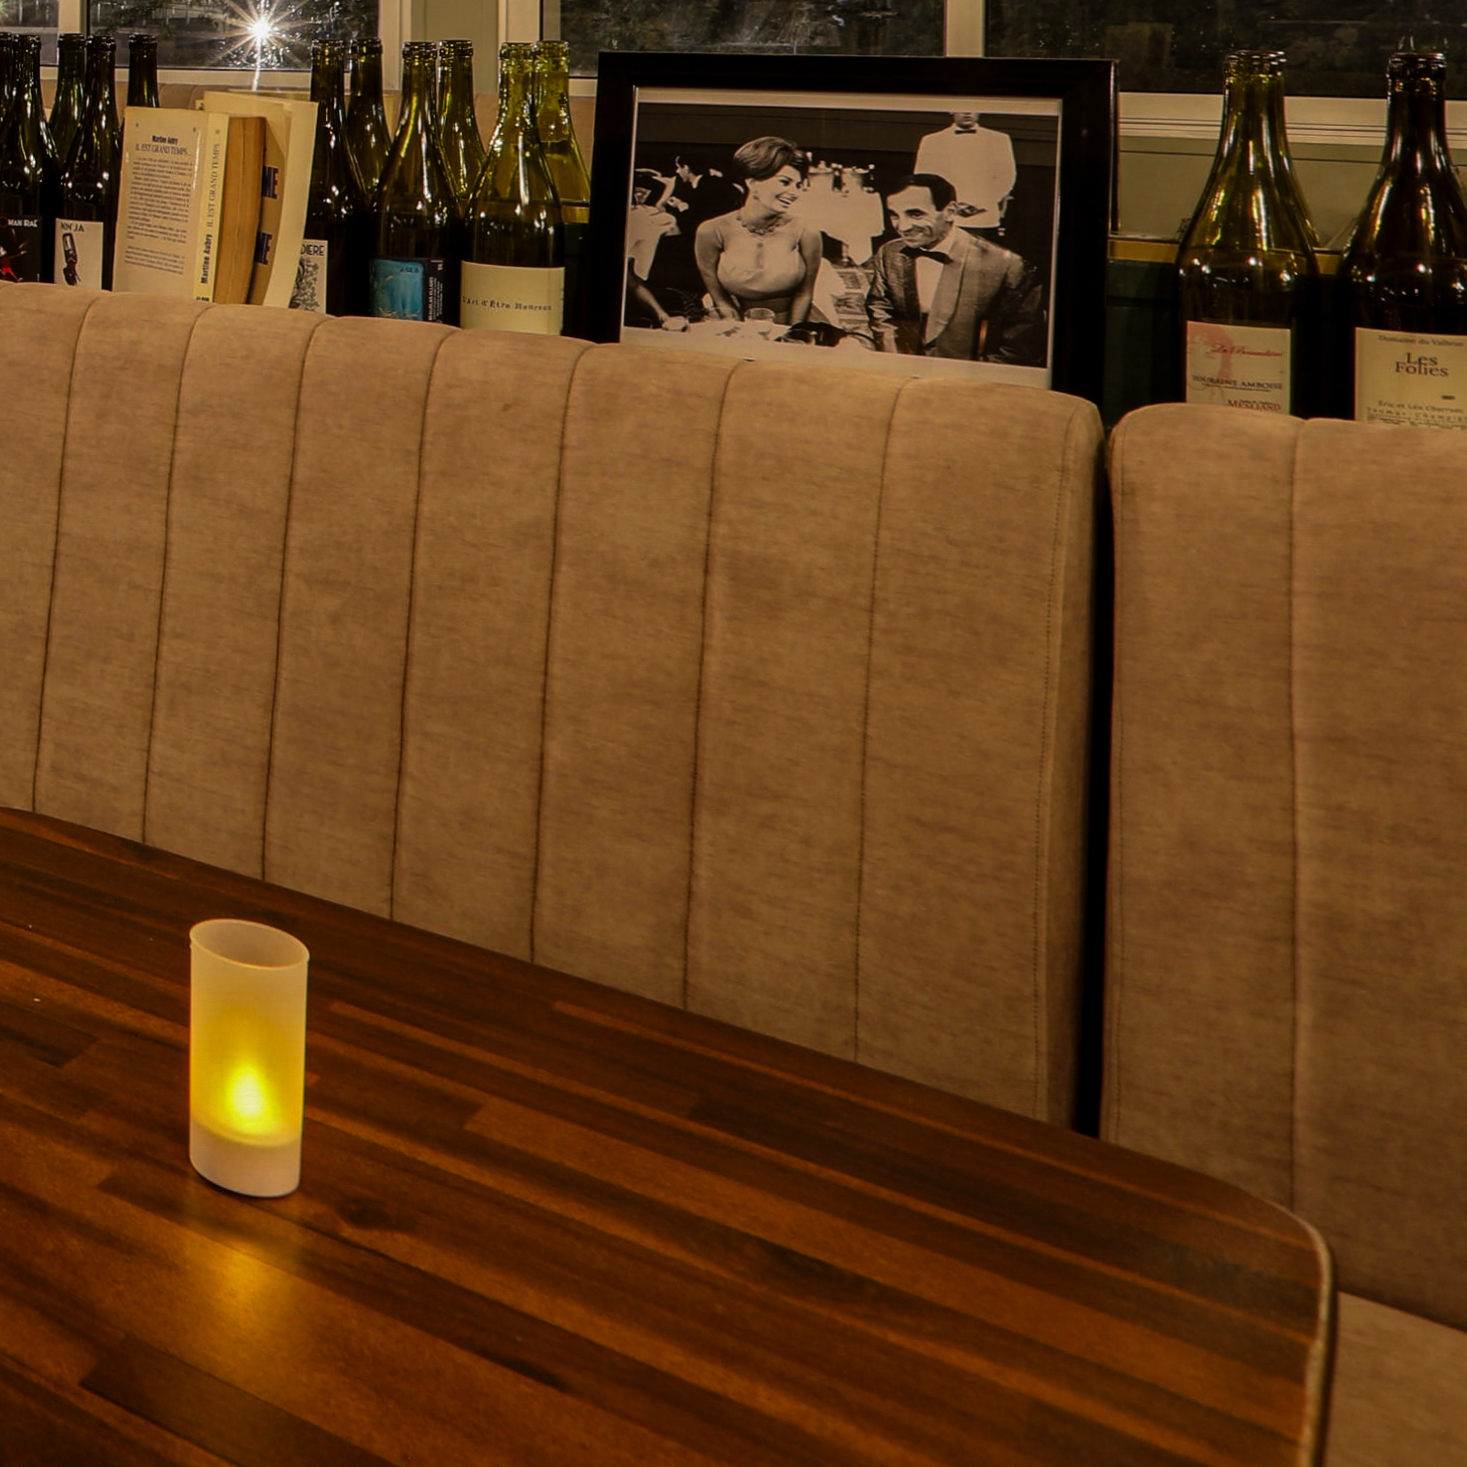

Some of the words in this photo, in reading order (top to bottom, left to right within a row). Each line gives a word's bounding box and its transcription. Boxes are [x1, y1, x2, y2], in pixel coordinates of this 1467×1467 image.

[201, 255, 211, 284] Martine
[1406, 351, 1439, 366] Les
[1395, 360, 1449, 378] Folies
